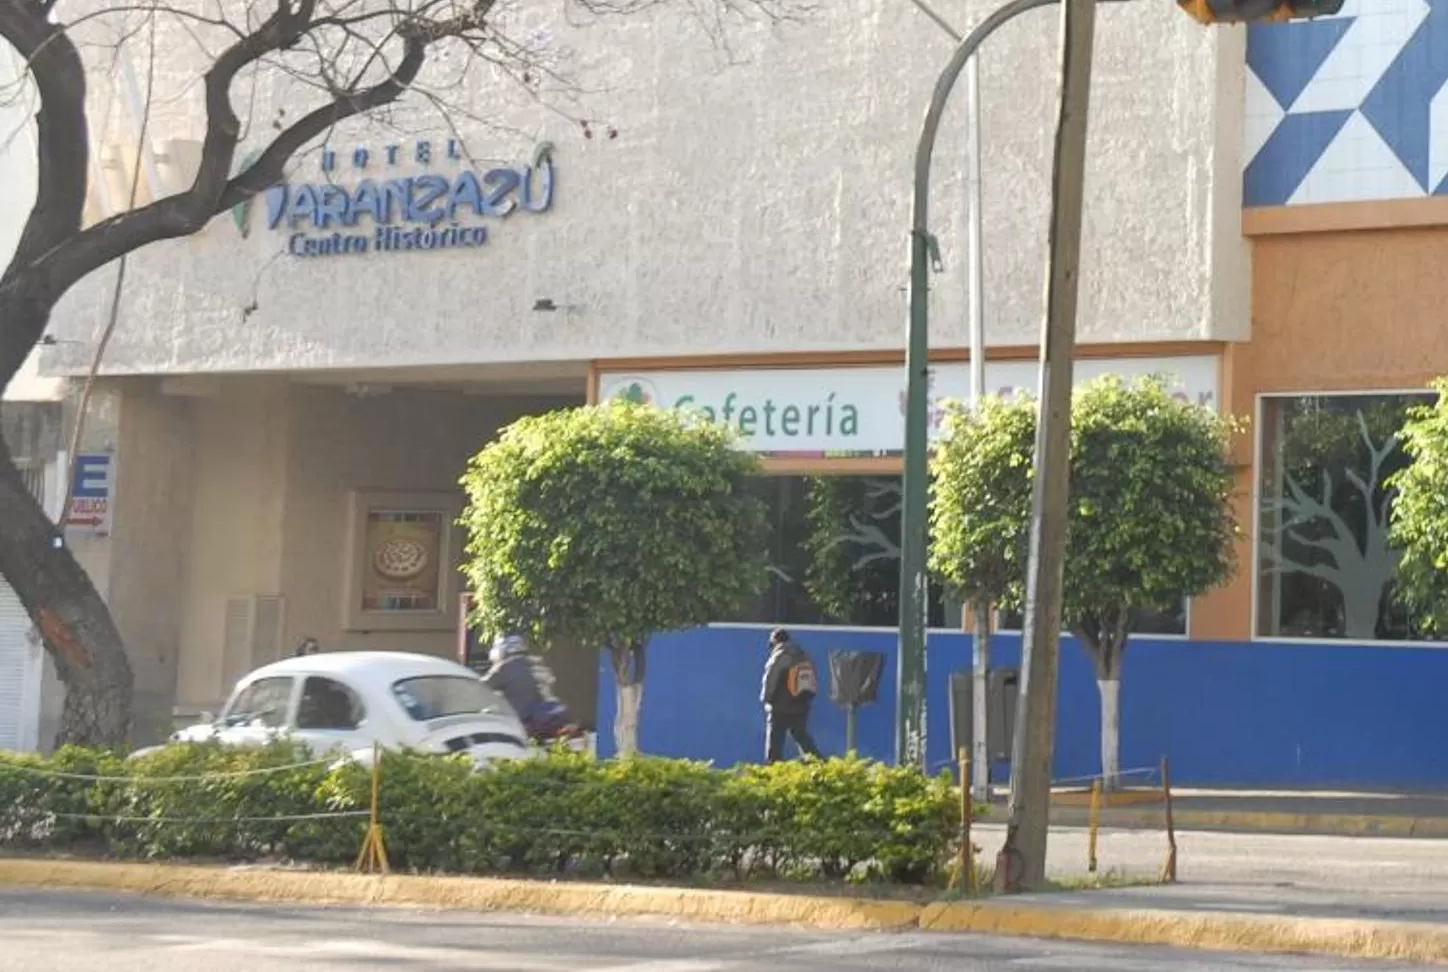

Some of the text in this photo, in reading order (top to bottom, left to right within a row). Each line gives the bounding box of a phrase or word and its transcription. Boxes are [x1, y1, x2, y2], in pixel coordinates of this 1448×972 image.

[322, 138, 461, 172] HOTEL
[289, 222, 487, 257] Centro Histórico
